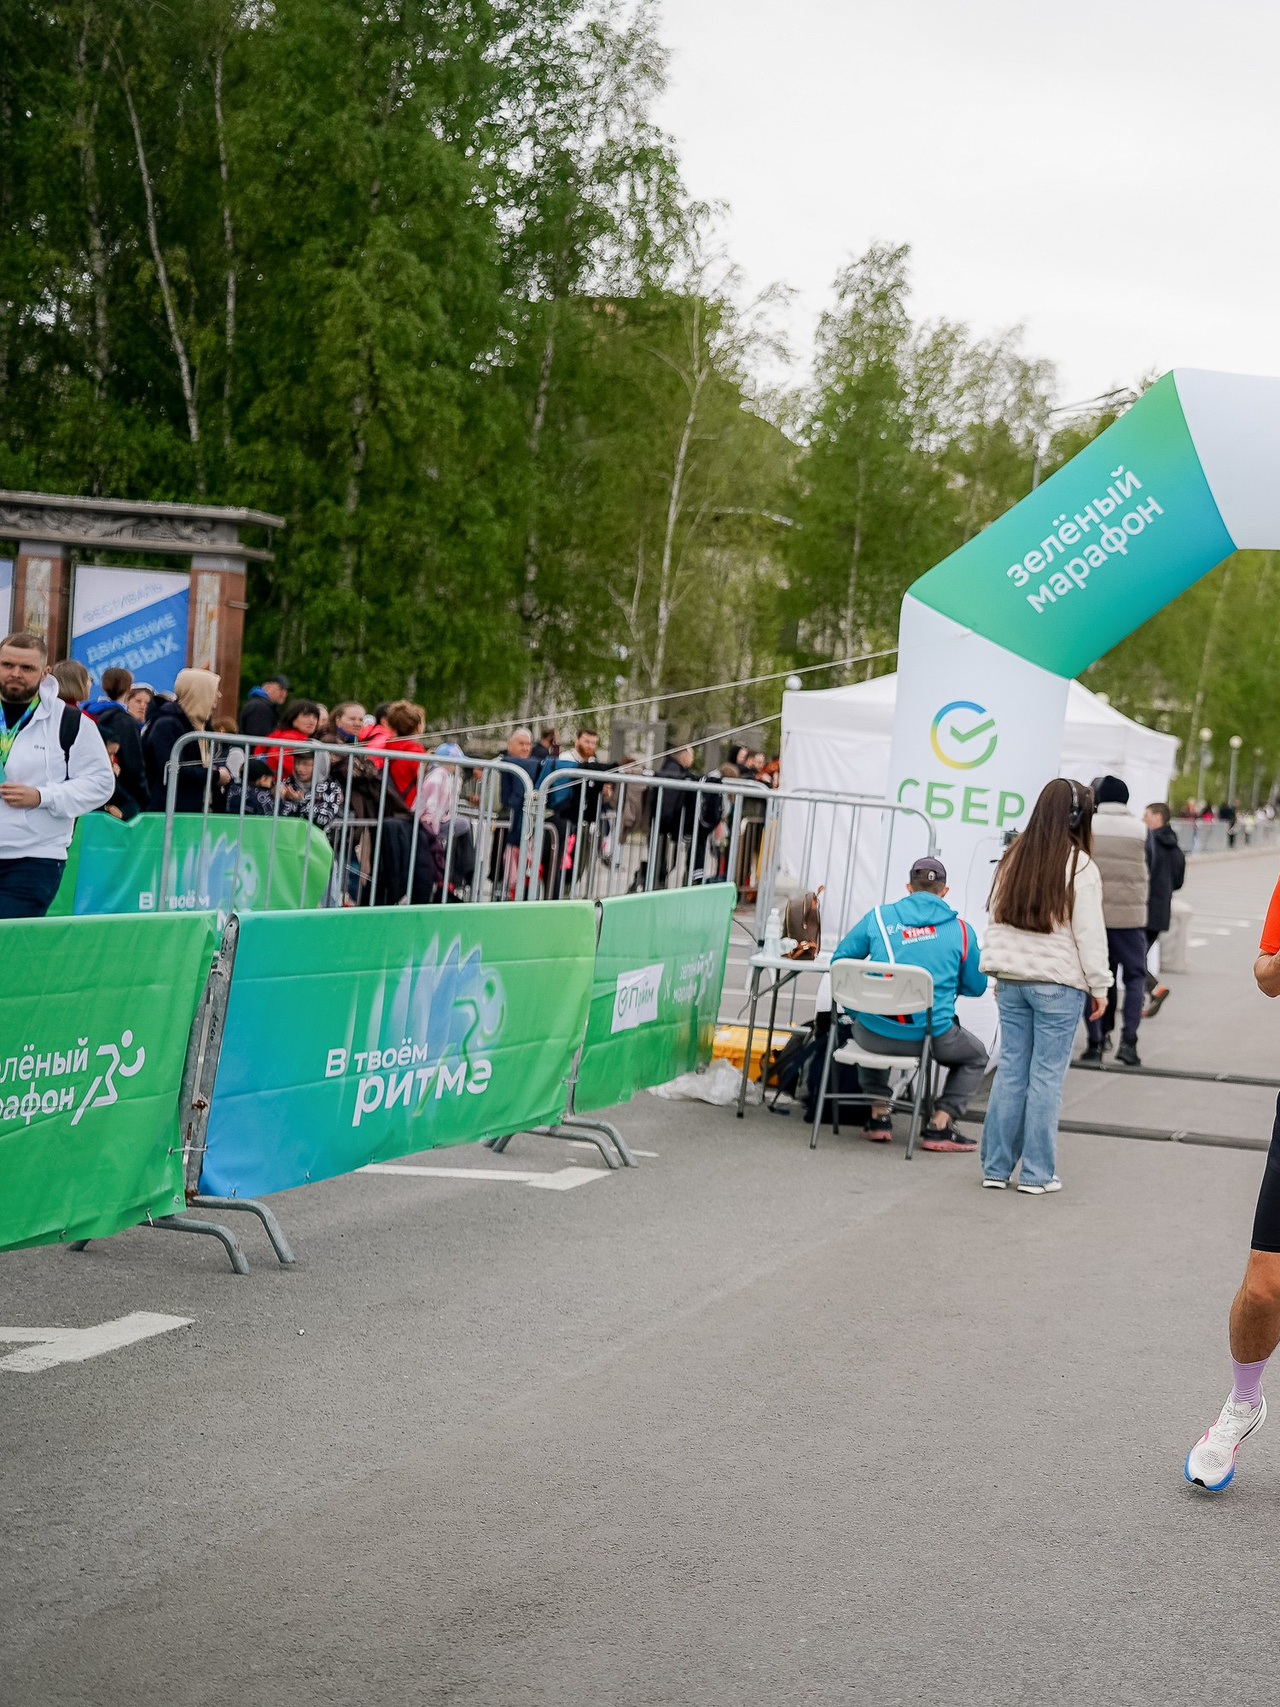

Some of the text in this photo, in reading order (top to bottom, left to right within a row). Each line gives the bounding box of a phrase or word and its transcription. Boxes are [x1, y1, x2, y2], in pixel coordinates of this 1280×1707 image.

[1006, 465, 1142, 588] зелёный
[1026, 496, 1165, 614] марафон
[897, 779, 1025, 828] СБЕР
[139, 891, 154, 910] В
[905, 925, 932, 939] TIME
[0, 1037, 89, 1084] лёный
[325, 1037, 428, 1078] В твоём
[0, 1081, 75, 1126] афон
